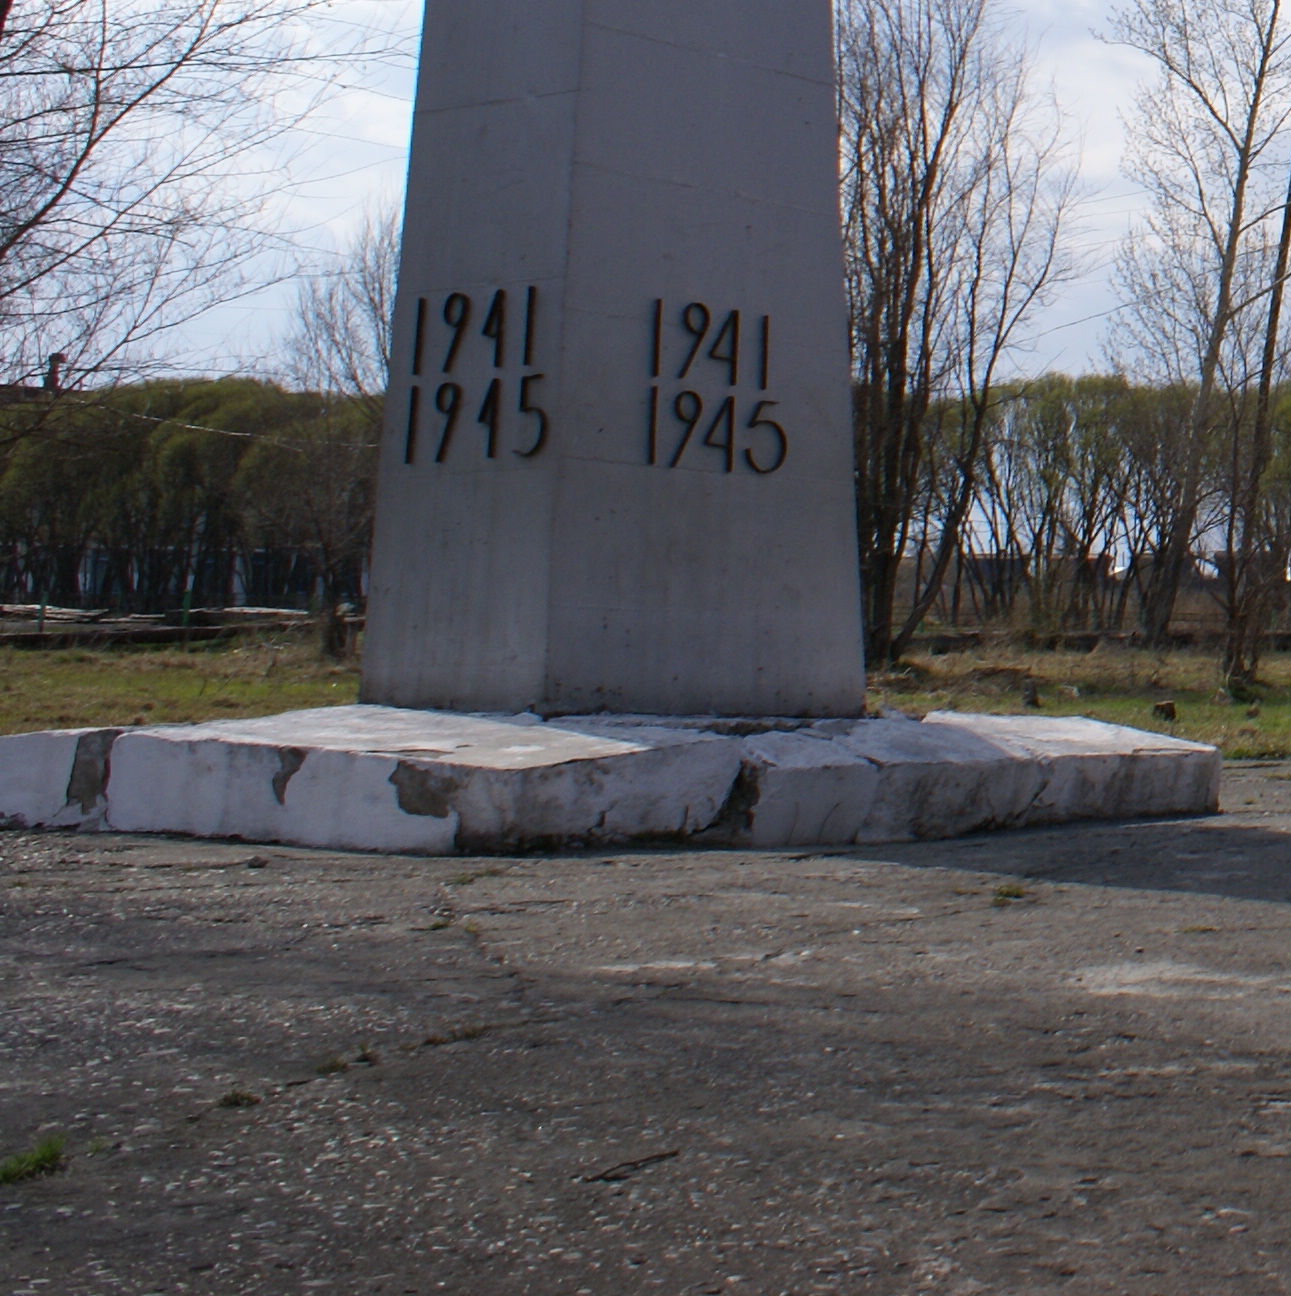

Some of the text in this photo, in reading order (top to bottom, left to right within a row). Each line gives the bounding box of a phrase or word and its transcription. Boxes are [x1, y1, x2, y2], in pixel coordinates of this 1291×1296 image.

[413, 286, 537, 375] 1941
[652, 298, 769, 390] 1941
[405, 374, 549, 464] 1945
[649, 385, 788, 474] 1945
